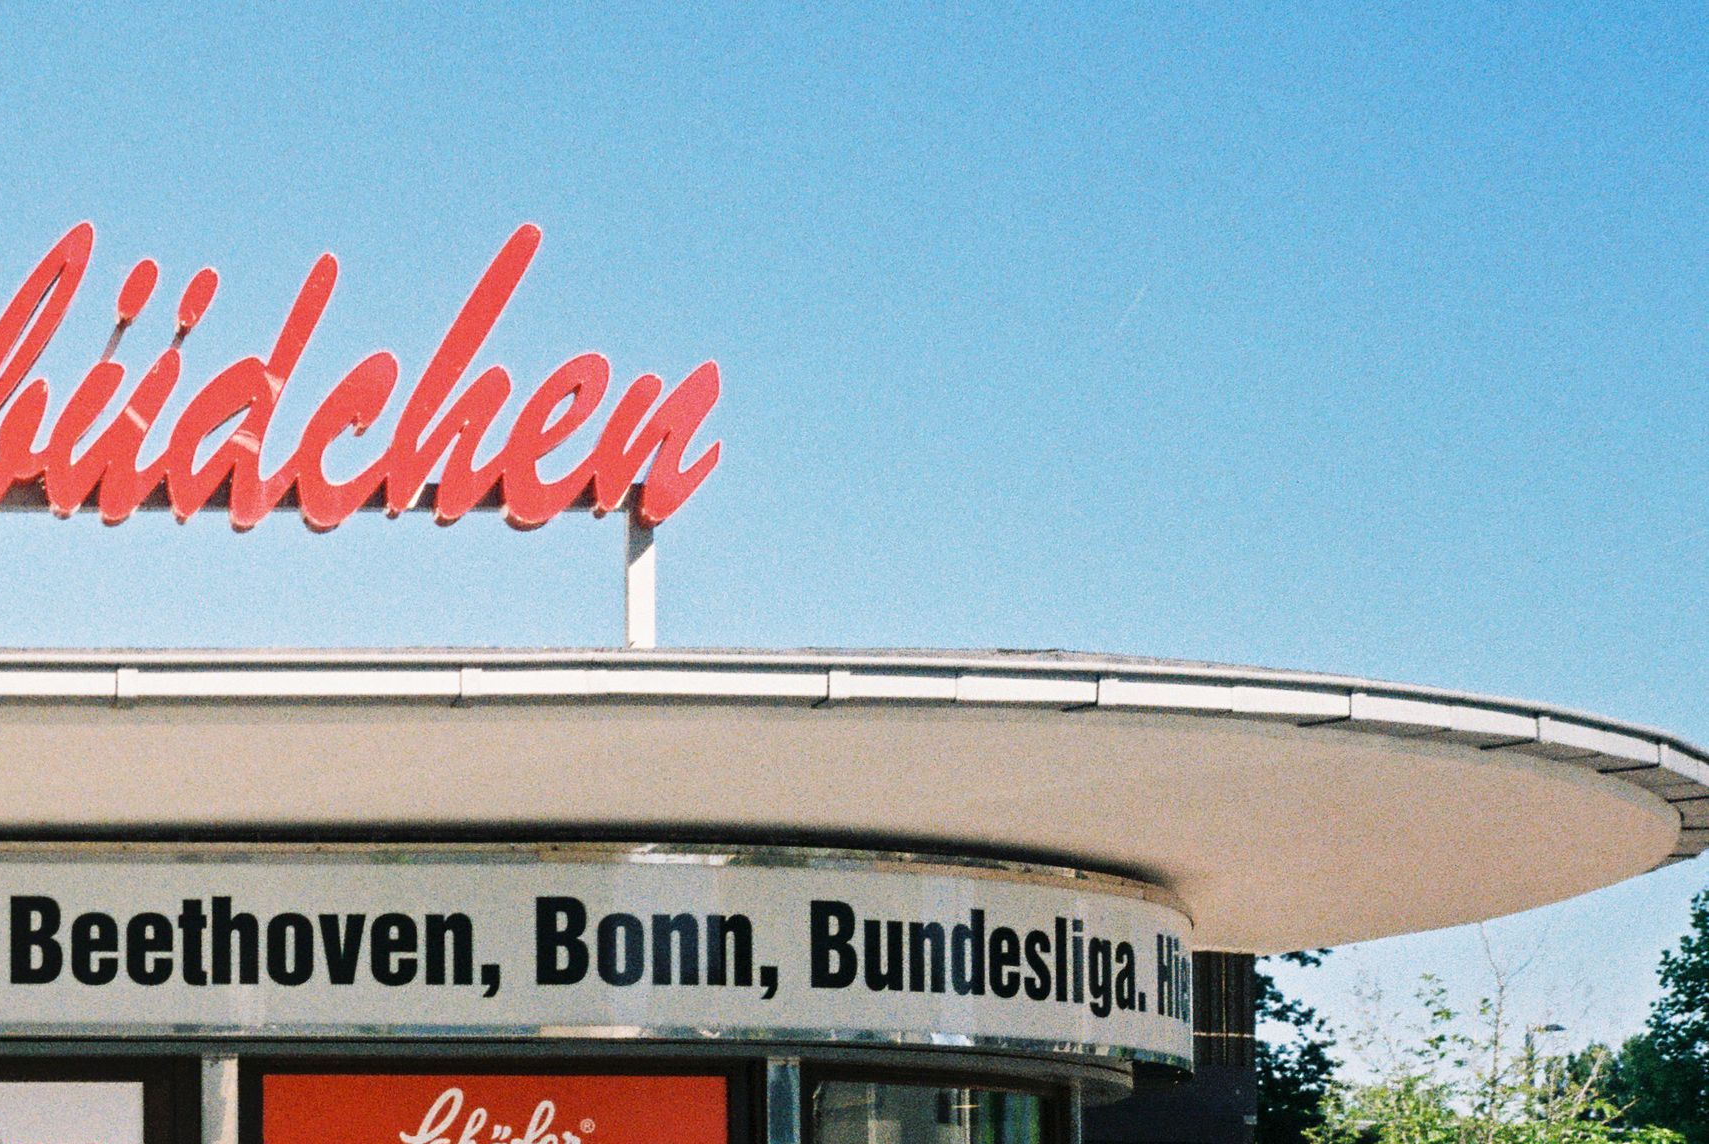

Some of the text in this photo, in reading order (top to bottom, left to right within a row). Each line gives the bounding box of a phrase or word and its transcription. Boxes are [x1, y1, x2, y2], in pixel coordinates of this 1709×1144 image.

[11, 896, 501, 997] Beethoven,
[536, 897, 779, 999] Bonn,
[810, 900, 1147, 1018] Bundesliga.
